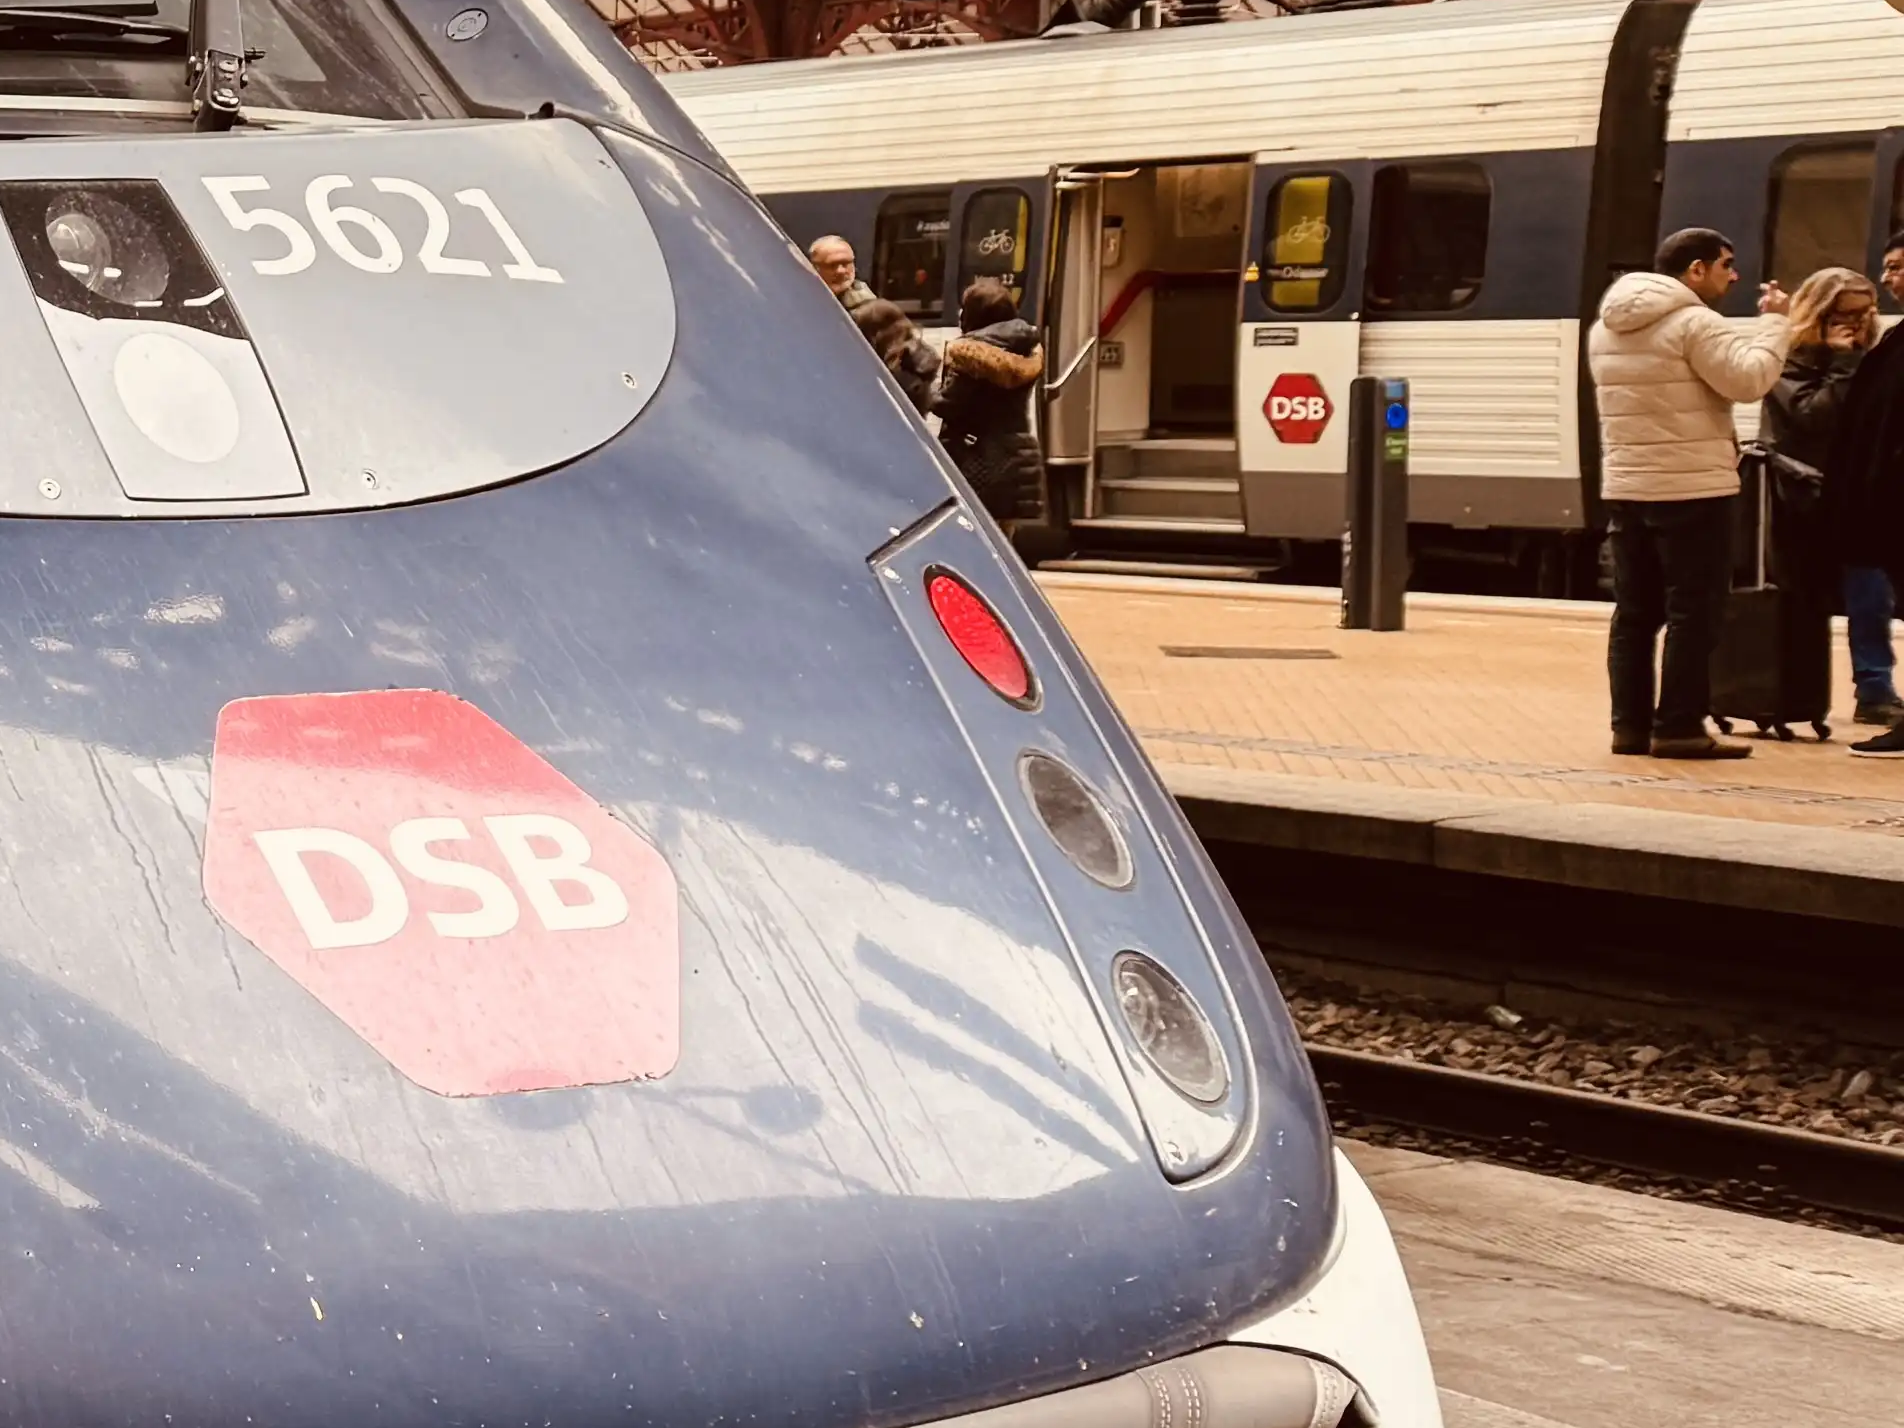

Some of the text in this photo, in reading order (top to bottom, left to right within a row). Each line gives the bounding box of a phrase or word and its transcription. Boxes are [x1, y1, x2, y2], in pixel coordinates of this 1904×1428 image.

[200, 173, 565, 284] 5621
[1269, 396, 1327, 421] DSB
[254, 812, 630, 951] DSB
